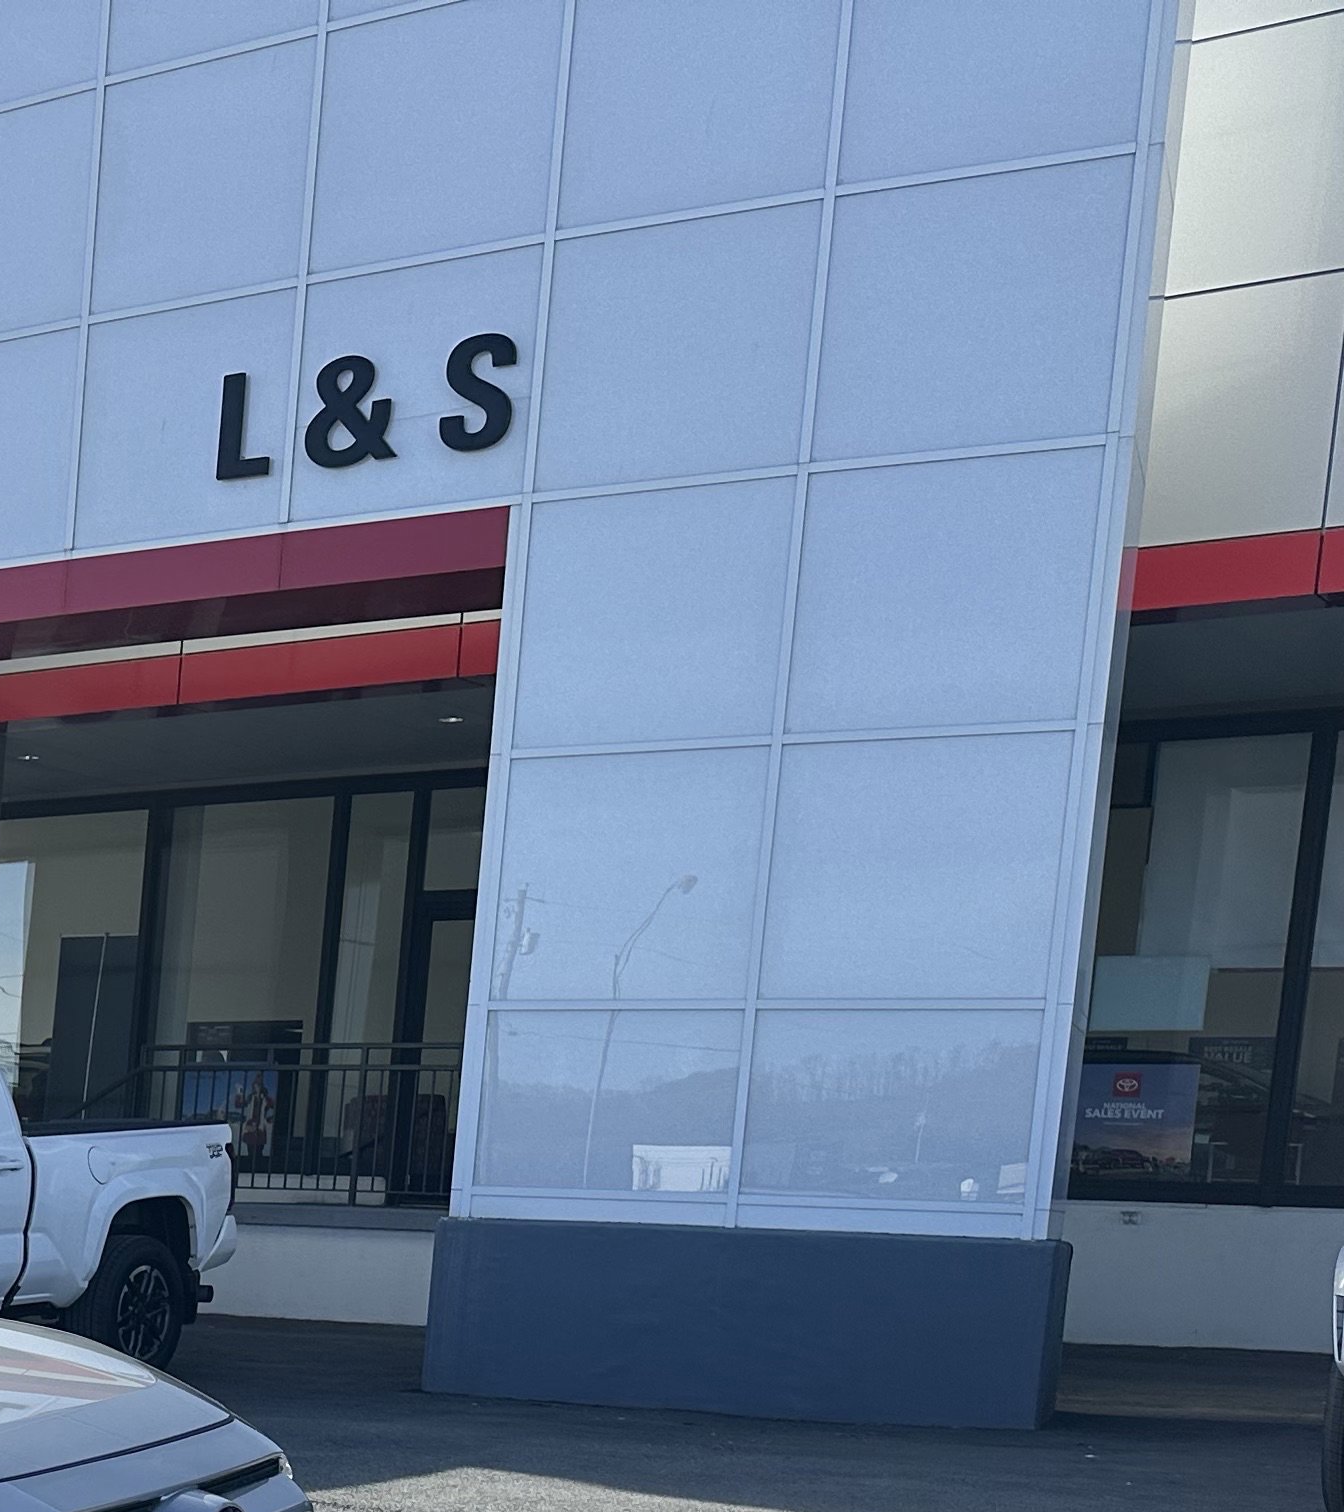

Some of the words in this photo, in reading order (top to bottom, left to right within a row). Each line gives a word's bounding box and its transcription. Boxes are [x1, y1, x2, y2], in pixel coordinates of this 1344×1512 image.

[216, 372, 270, 480] L
[304, 355, 397, 468] &
[439, 333, 517, 452] S
[1085, 1107, 1121, 1119] SALES
[1124, 1108, 1164, 1119] EVENT
